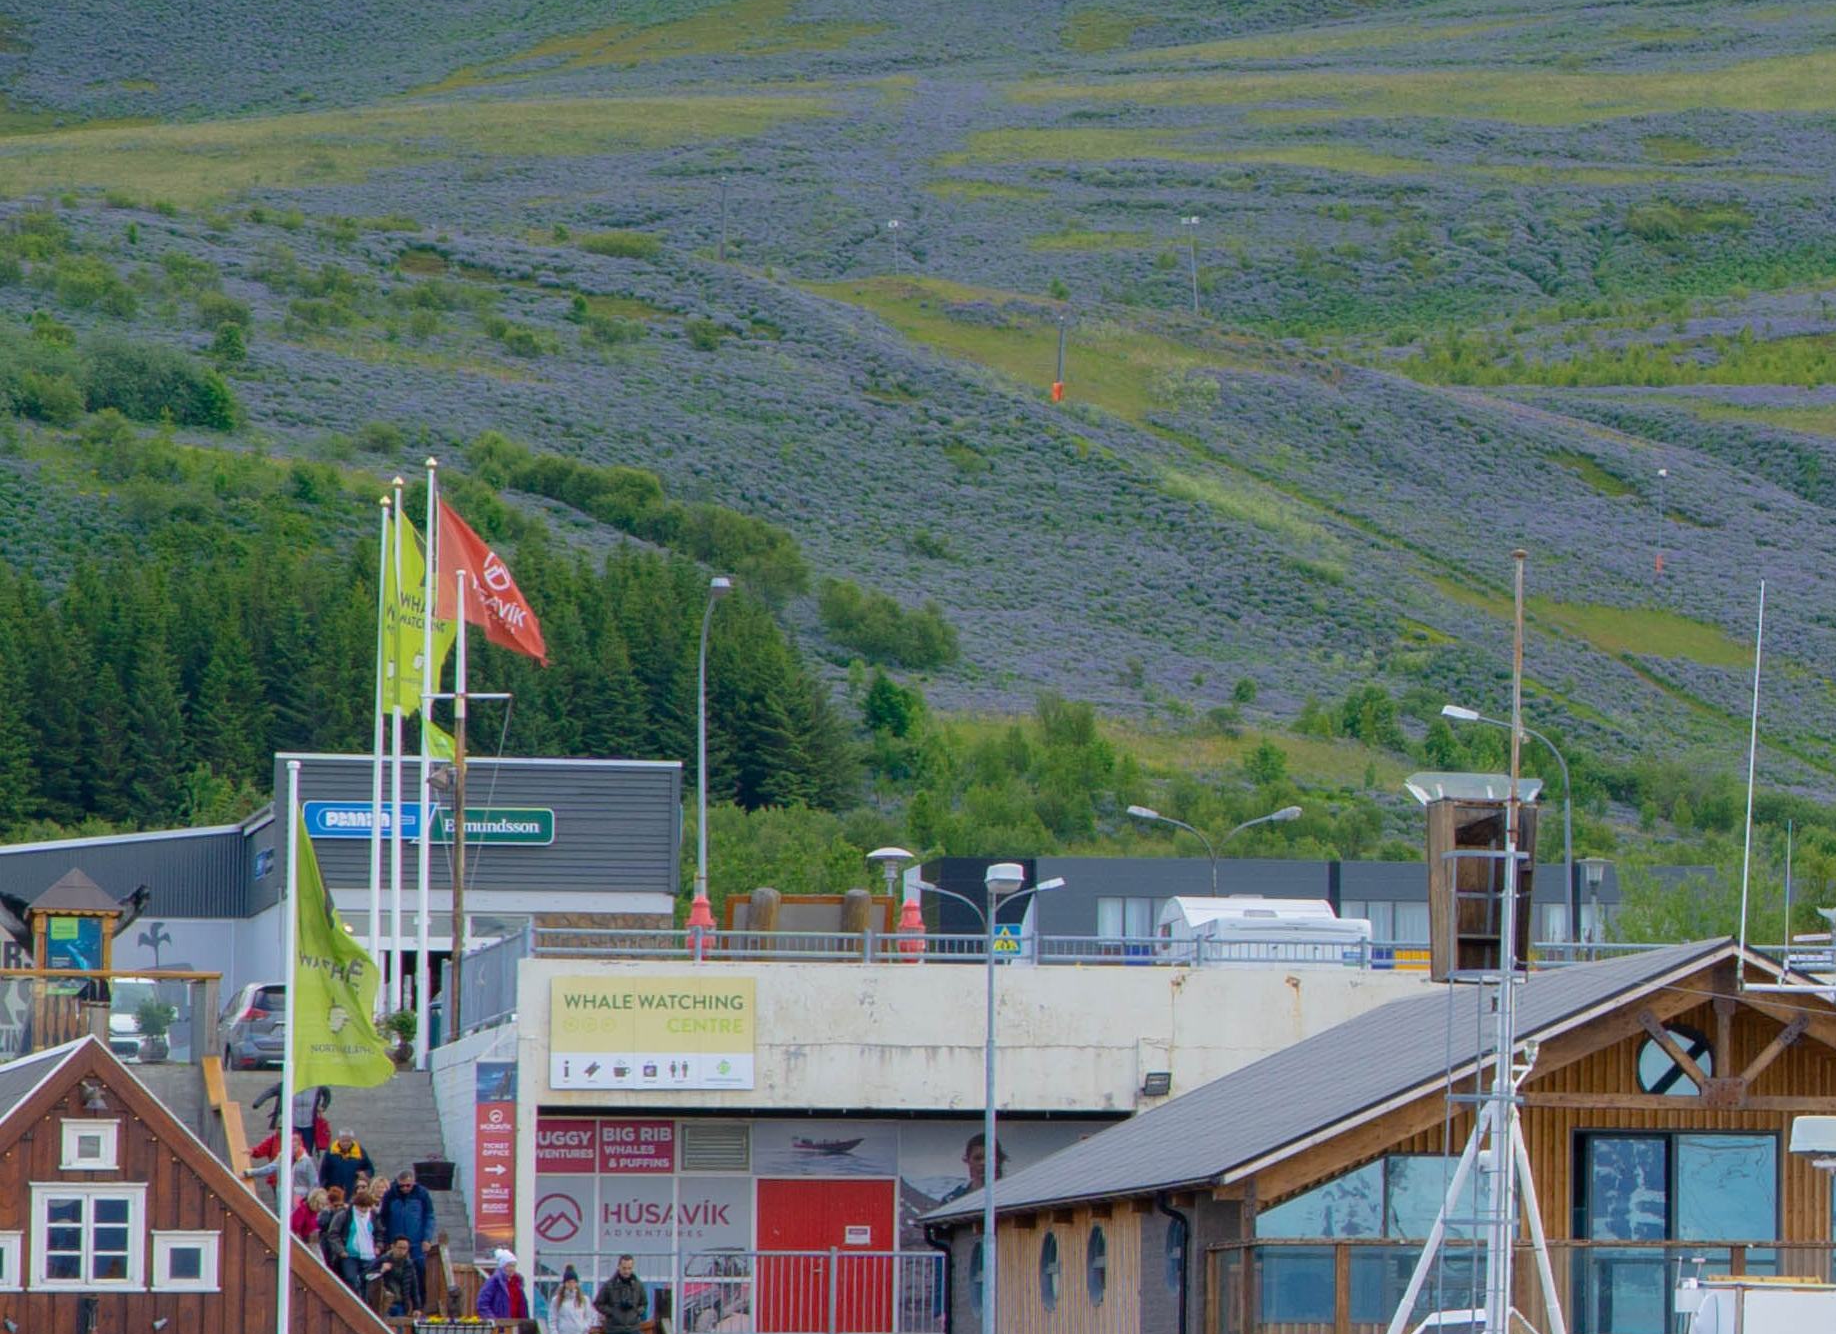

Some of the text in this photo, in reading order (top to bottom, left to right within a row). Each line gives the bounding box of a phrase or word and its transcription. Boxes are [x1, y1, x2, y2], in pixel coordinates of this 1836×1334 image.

[444, 818, 540, 834] Emundsson
[564, 994, 744, 1010] WHALE WATCHING
[666, 1018, 743, 1034] CENTRE
[537, 1130, 592, 1146] UGGY
[602, 1127, 672, 1142] BIG RIB
[536, 1148, 594, 1158] VENTURES
[604, 1145, 655, 1154] WHALES
[608, 1157, 670, 1168] & PUFFINS
[604, 1199, 730, 1226] HÚSAVÍK
[604, 1229, 704, 1238] ADVENTURES
